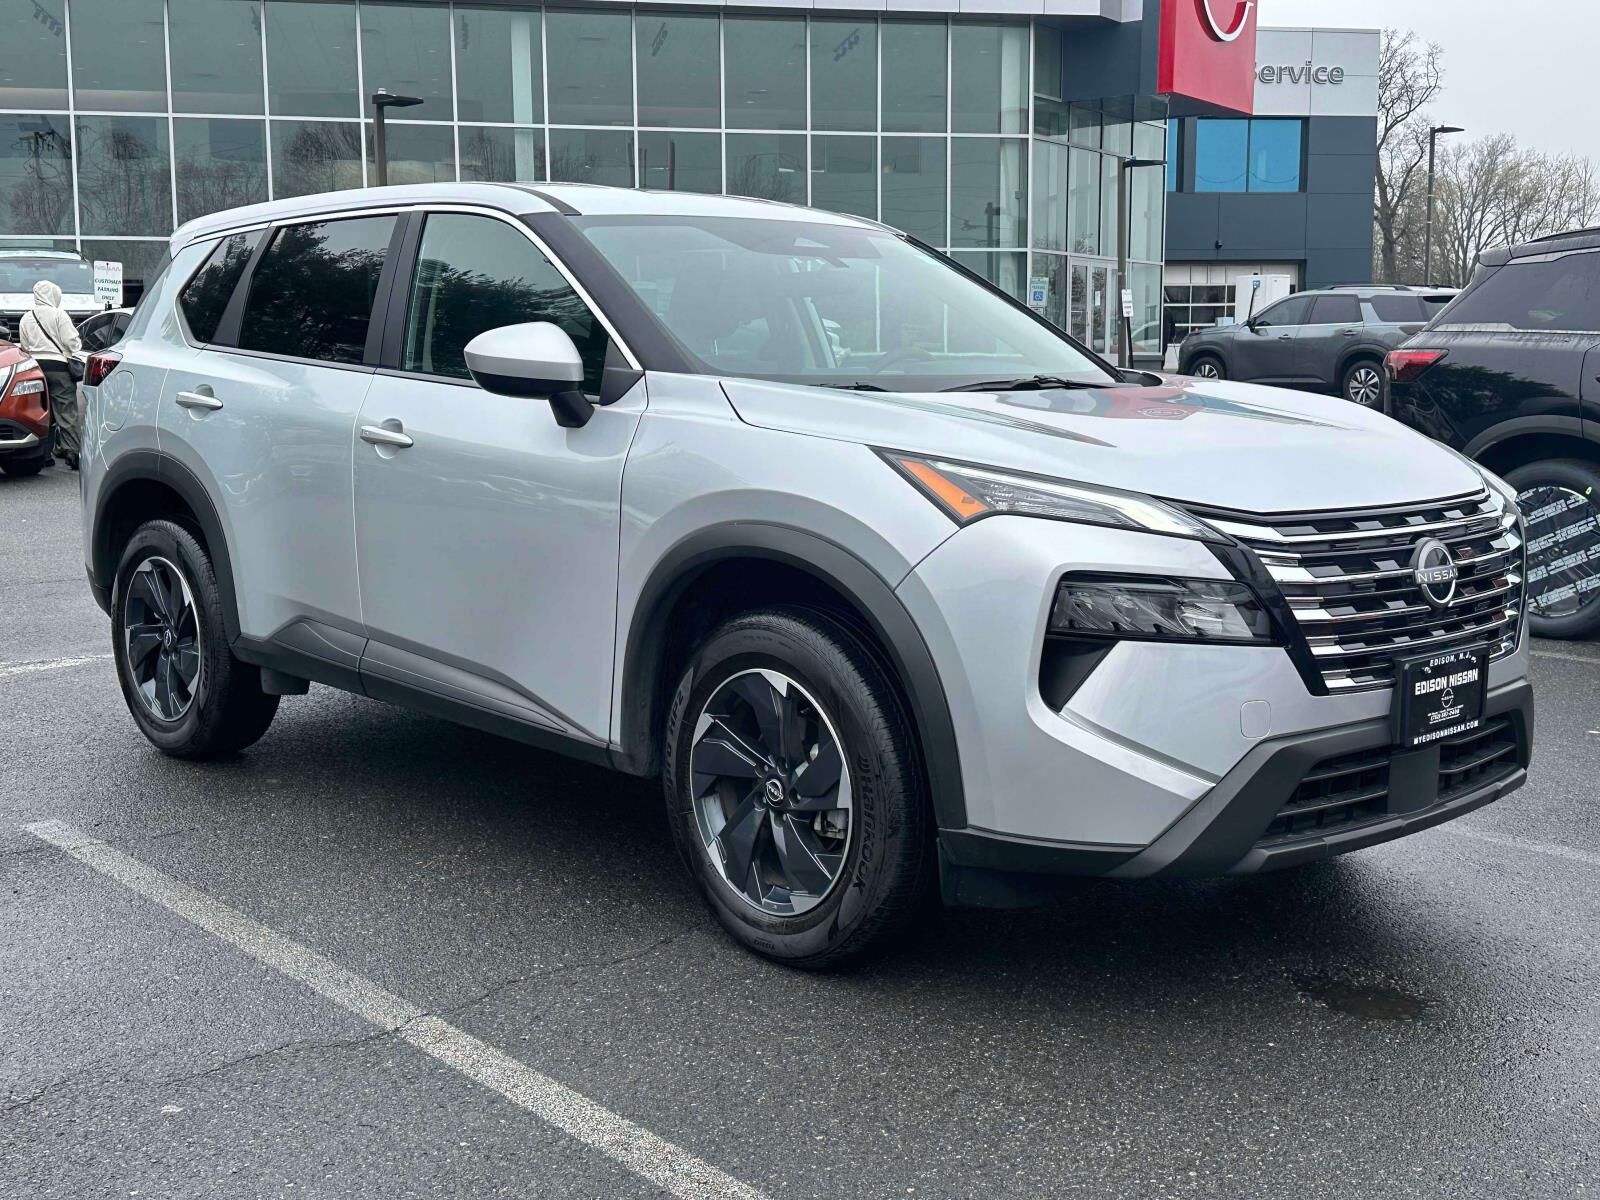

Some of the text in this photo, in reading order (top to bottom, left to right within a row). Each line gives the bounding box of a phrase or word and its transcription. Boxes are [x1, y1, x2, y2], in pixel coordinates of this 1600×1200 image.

[1254, 61, 1344, 85] ervice
[1417, 567, 1458, 582] NISSAN
[1414, 668, 1479, 696] EDISON NISSAN
[1413, 719, 1479, 745] MYEDISONNISSAN.COM
